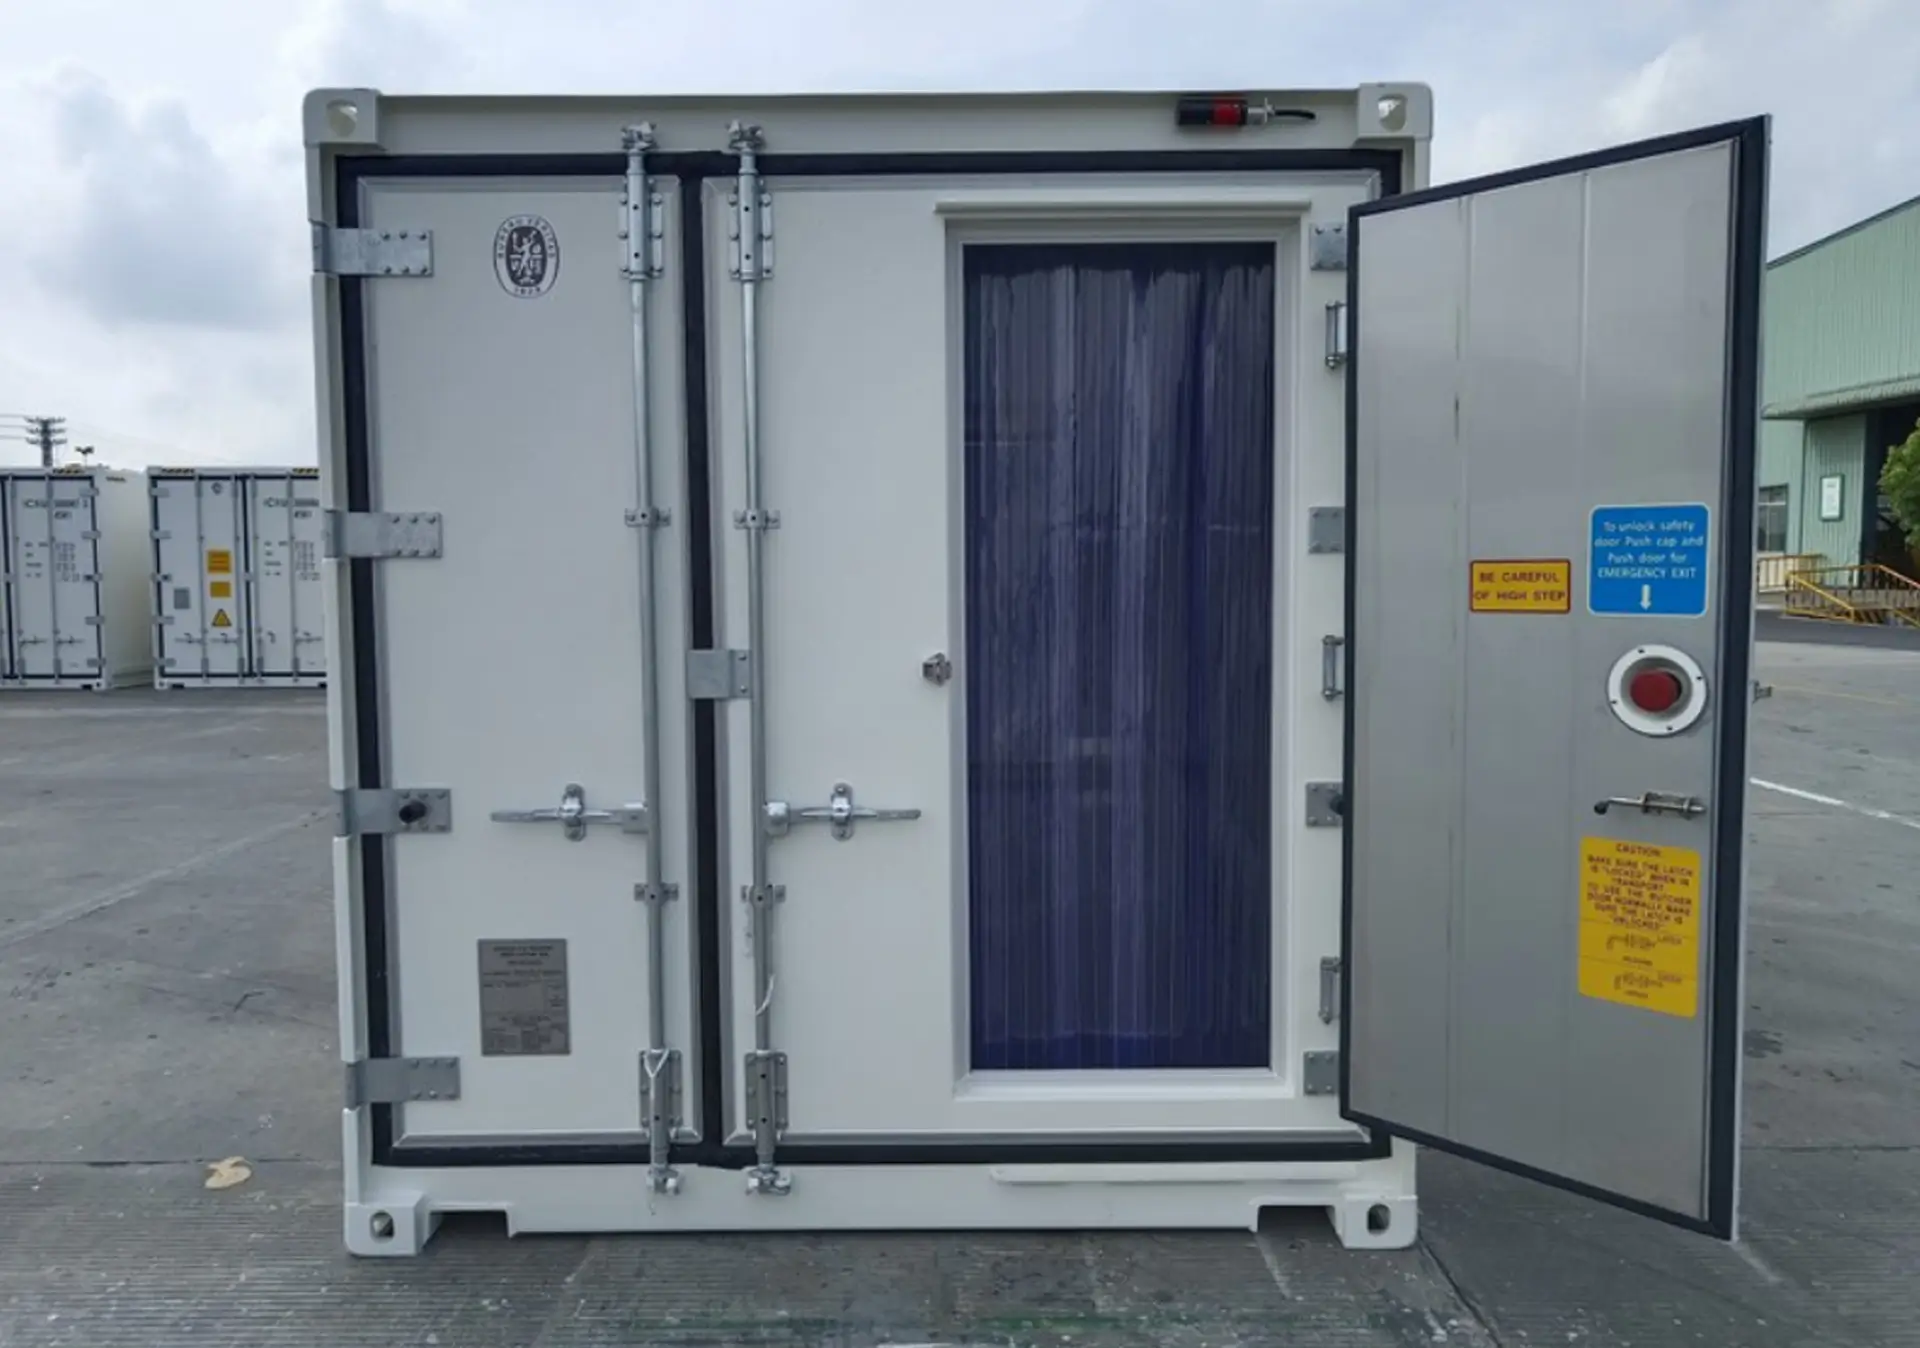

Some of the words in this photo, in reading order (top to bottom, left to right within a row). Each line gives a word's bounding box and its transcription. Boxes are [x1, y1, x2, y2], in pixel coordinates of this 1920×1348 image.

[1603, 522, 1616, 533] To
[1619, 520, 1655, 532] unlock
[1660, 520, 1695, 533] safety
[1656, 537, 1677, 549] cap
[1681, 535, 1704, 546] and
[1607, 552, 1634, 564] Push
[1638, 552, 1665, 564] door
[1669, 552, 1688, 563] for
[1479, 571, 1496, 583] BE
[1501, 571, 1560, 583] CAREFUL
[1597, 567, 1667, 579] EMERGENCY
[1671, 567, 1697, 579] EXIT
[1474, 590, 1490, 601] OF
[1496, 590, 1527, 601] HIGH
[1533, 589, 1566, 601] STEP
